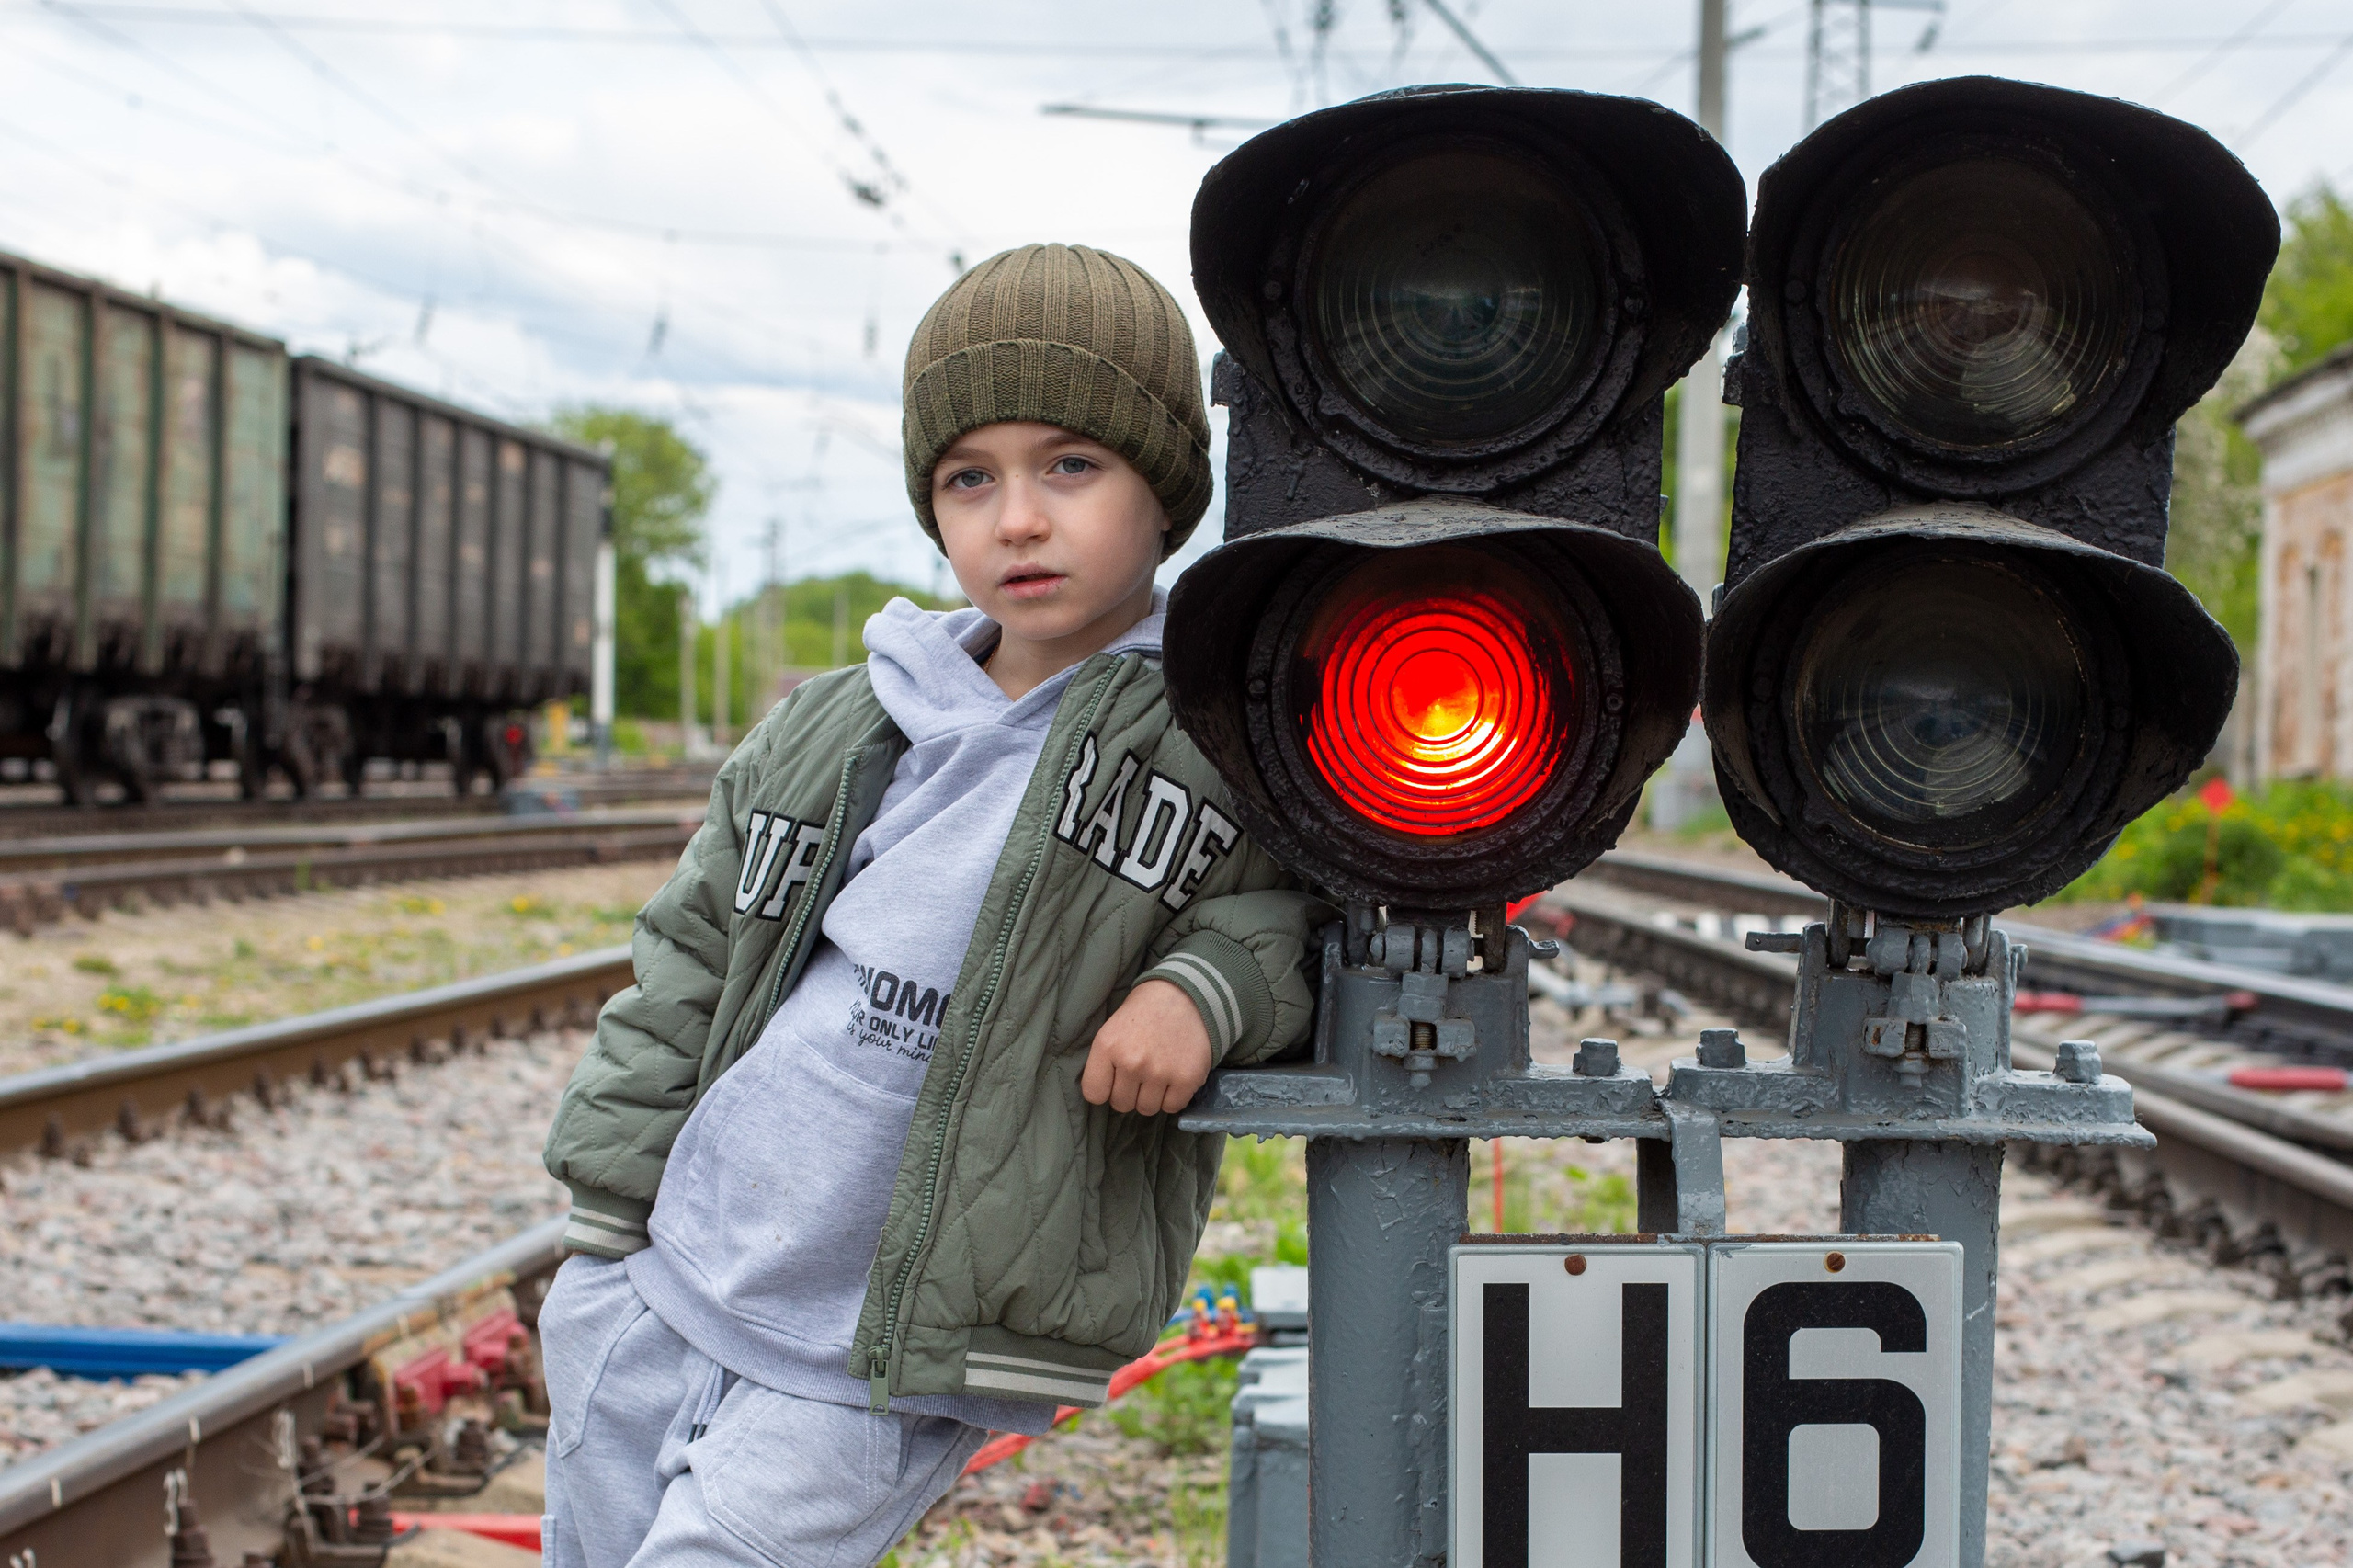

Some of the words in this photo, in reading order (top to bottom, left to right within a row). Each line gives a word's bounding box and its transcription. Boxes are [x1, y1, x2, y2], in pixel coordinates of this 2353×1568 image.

[733, 809, 825, 922] UP
[858, 1028, 892, 1051] your
[869, 1016, 914, 1043] ONLY
[917, 1032, 938, 1051] LI
